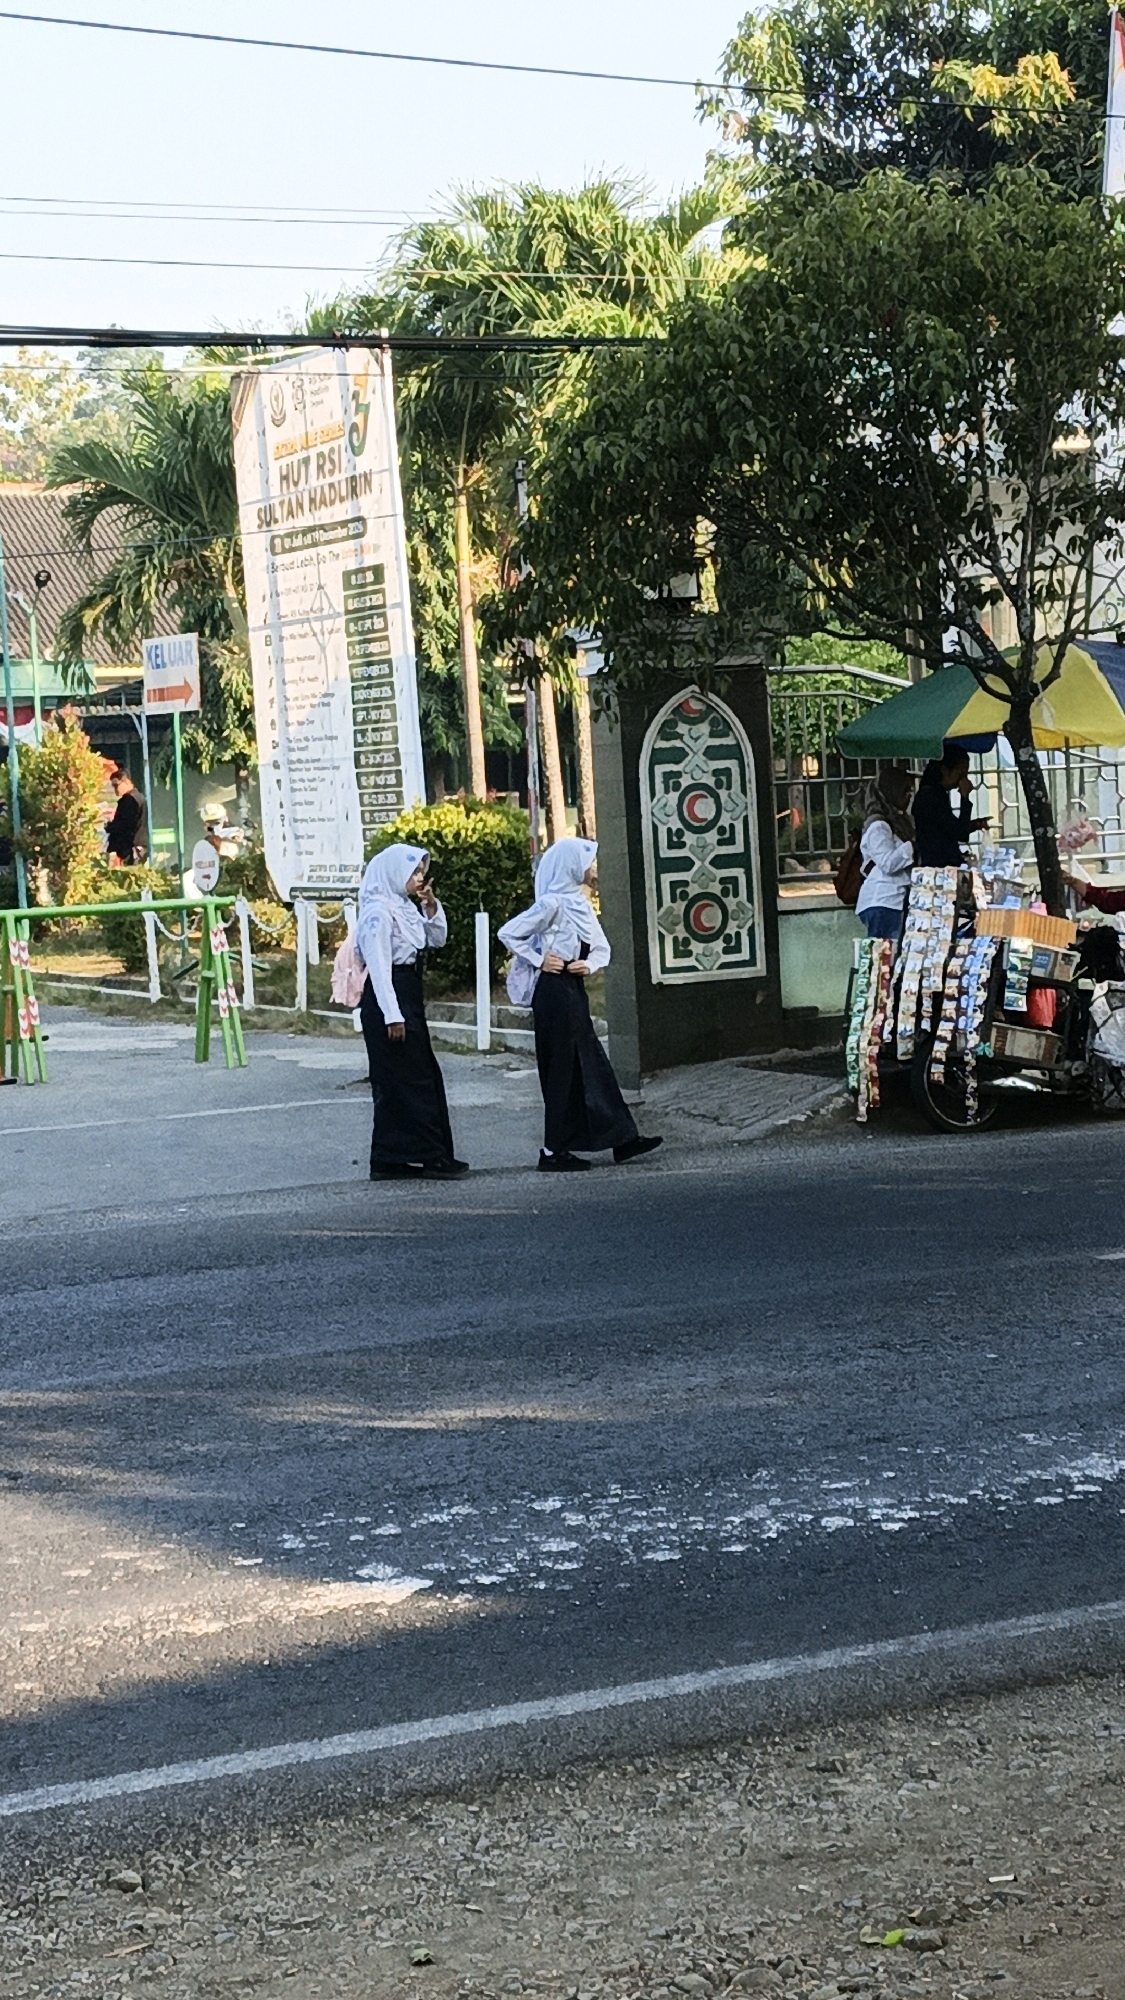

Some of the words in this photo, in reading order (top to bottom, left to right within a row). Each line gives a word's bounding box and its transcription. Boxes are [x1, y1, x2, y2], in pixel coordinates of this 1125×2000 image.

[279, 455, 310, 493] HUT
[316, 444, 342, 481] RSI
[257, 493, 304, 530] SULTAN
[308, 469, 372, 512] HADLIRIN
[146, 640, 194, 670] KELUAR
